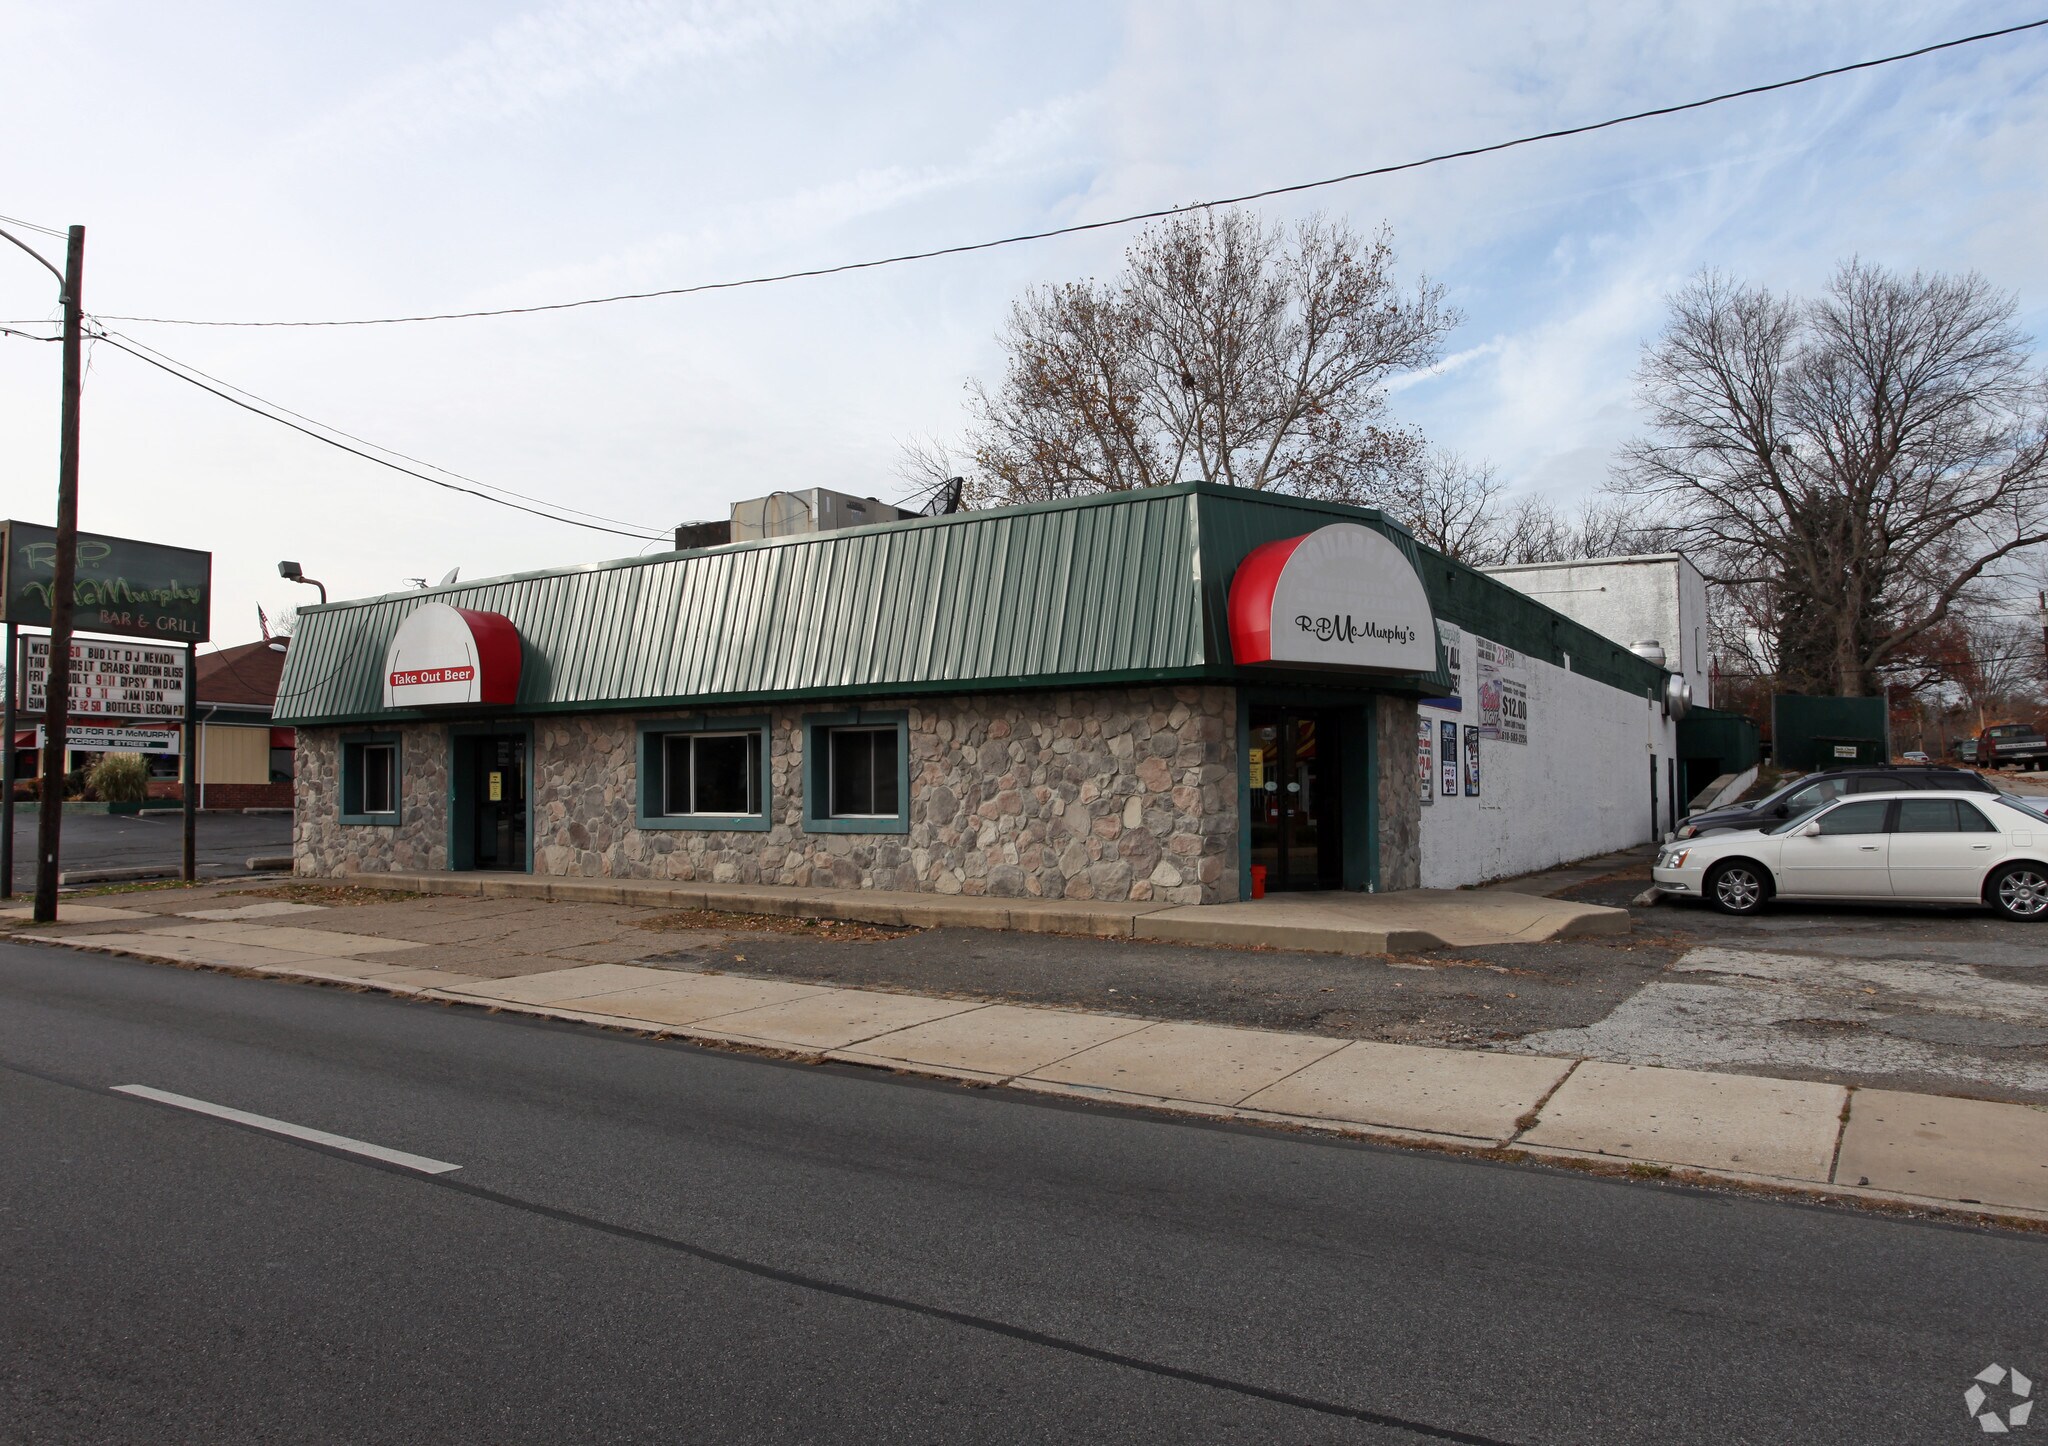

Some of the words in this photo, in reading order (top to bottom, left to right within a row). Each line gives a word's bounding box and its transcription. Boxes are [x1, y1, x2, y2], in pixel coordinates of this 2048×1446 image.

[100, 610, 131, 626] BAR
[138, 614, 149, 627] &
[156, 616, 200, 634] GRILL
[31, 643, 49, 655] WED
[144, 652, 175, 665] NEVADA
[1497, 645, 1505, 665] 23
[28, 656, 45, 668] THU
[100, 662, 130, 674] CRABS
[132, 664, 161, 677] MODERN
[163, 667, 183, 678] BLISS
[28, 671, 43, 681] FRI
[120, 676, 147, 688] GYPSY
[393, 673, 418, 685] Take
[421, 671, 441, 682] Out
[444, 669, 471, 681] Beer
[86, 687, 92, 698] 9
[122, 689, 164, 702] JAMISON
[28, 697, 44, 709] SUN
[106, 702, 141, 714] BOTTLES
[146, 704, 185, 716] LECOMPT
[1502, 694, 1527, 720] $12.00
[85, 728, 104, 736] FOR
[126, 730, 176, 739] McMURPHY
